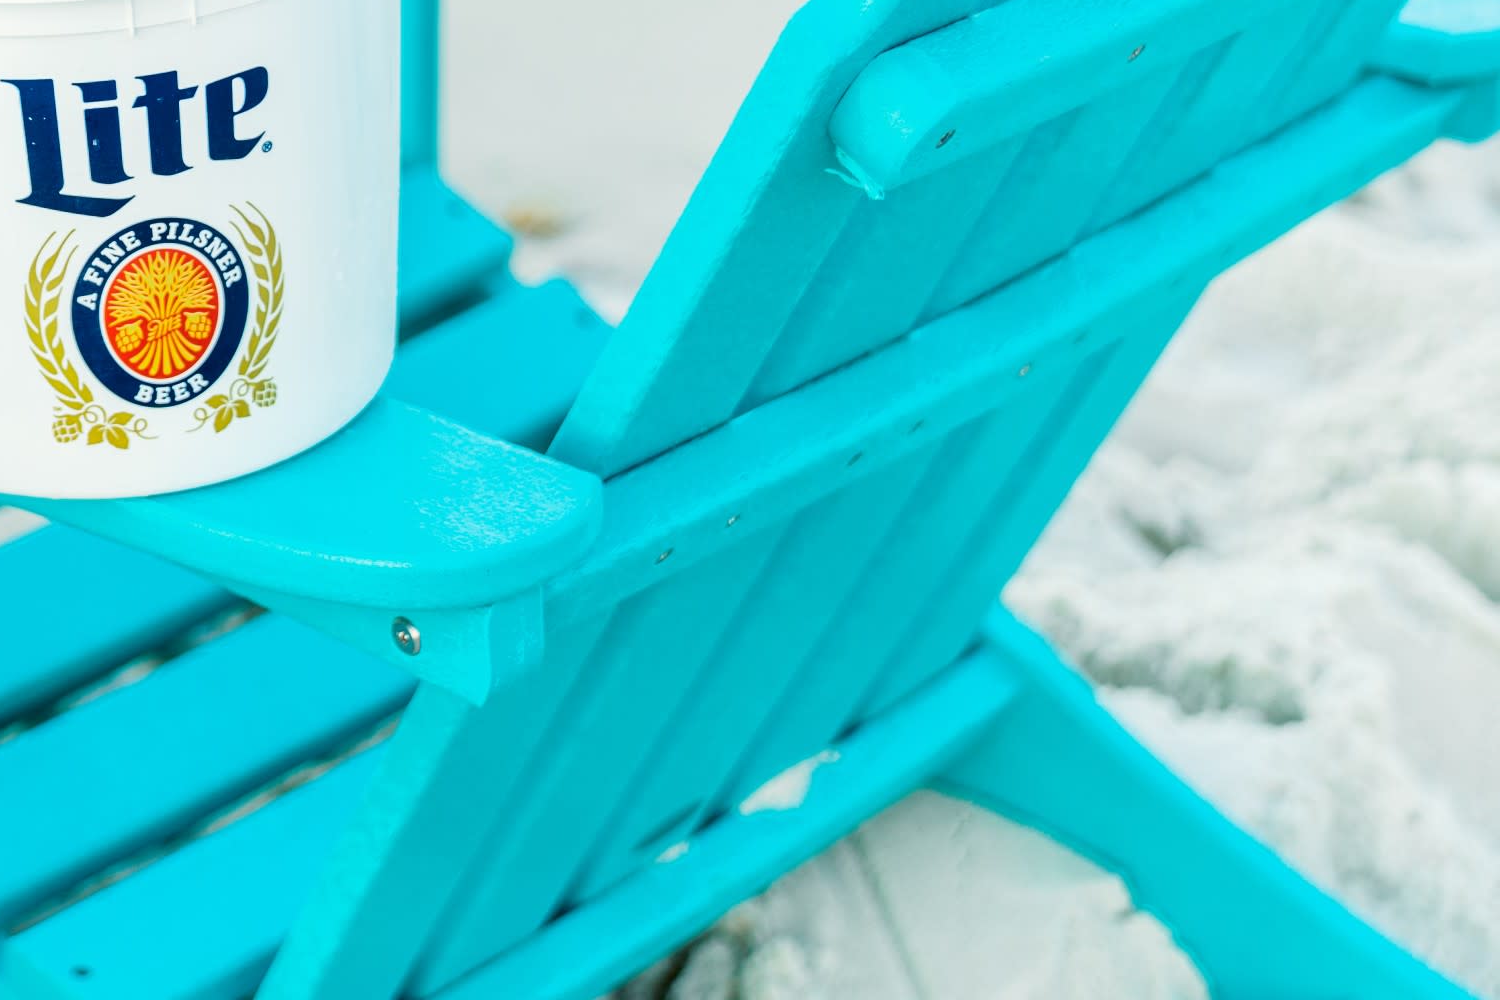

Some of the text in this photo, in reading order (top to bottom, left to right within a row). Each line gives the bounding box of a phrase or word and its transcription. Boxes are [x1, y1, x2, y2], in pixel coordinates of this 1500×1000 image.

[0, 66, 268, 217] Lite
[77, 222, 241, 310] A FINE PILSNER
[134, 373, 209, 404] BEER
